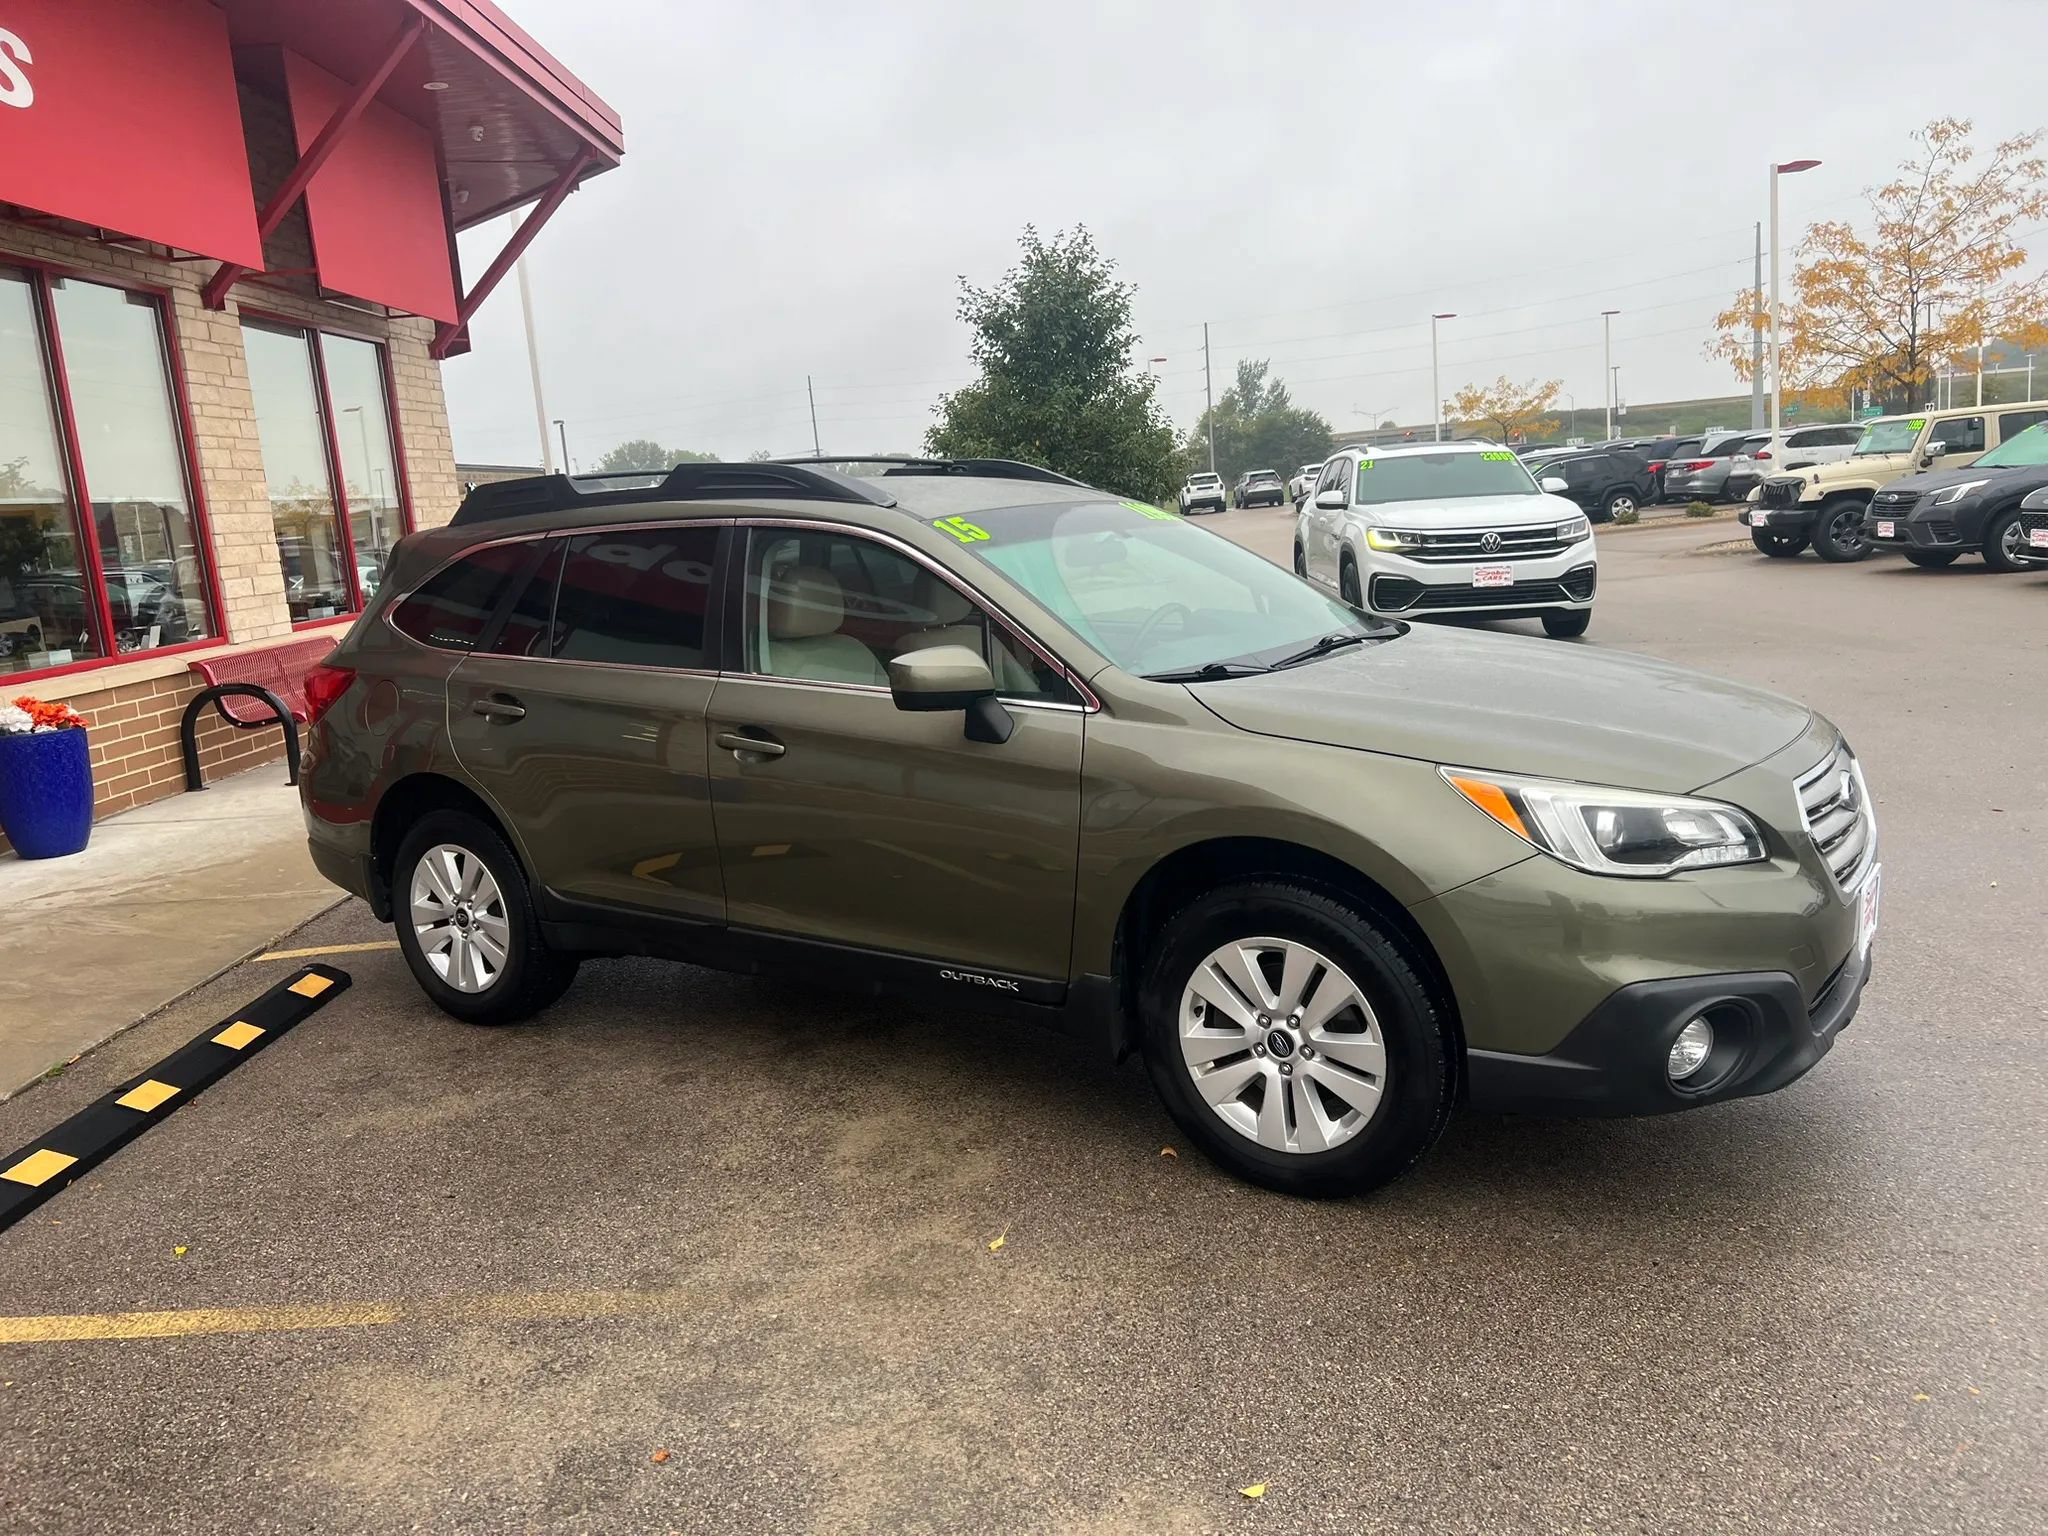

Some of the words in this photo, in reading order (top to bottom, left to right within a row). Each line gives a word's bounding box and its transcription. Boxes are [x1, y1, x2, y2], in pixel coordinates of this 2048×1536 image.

[1360, 459, 1375, 470] 21
[932, 516, 991, 544] 15
[939, 969, 1020, 993] OUTBACK
